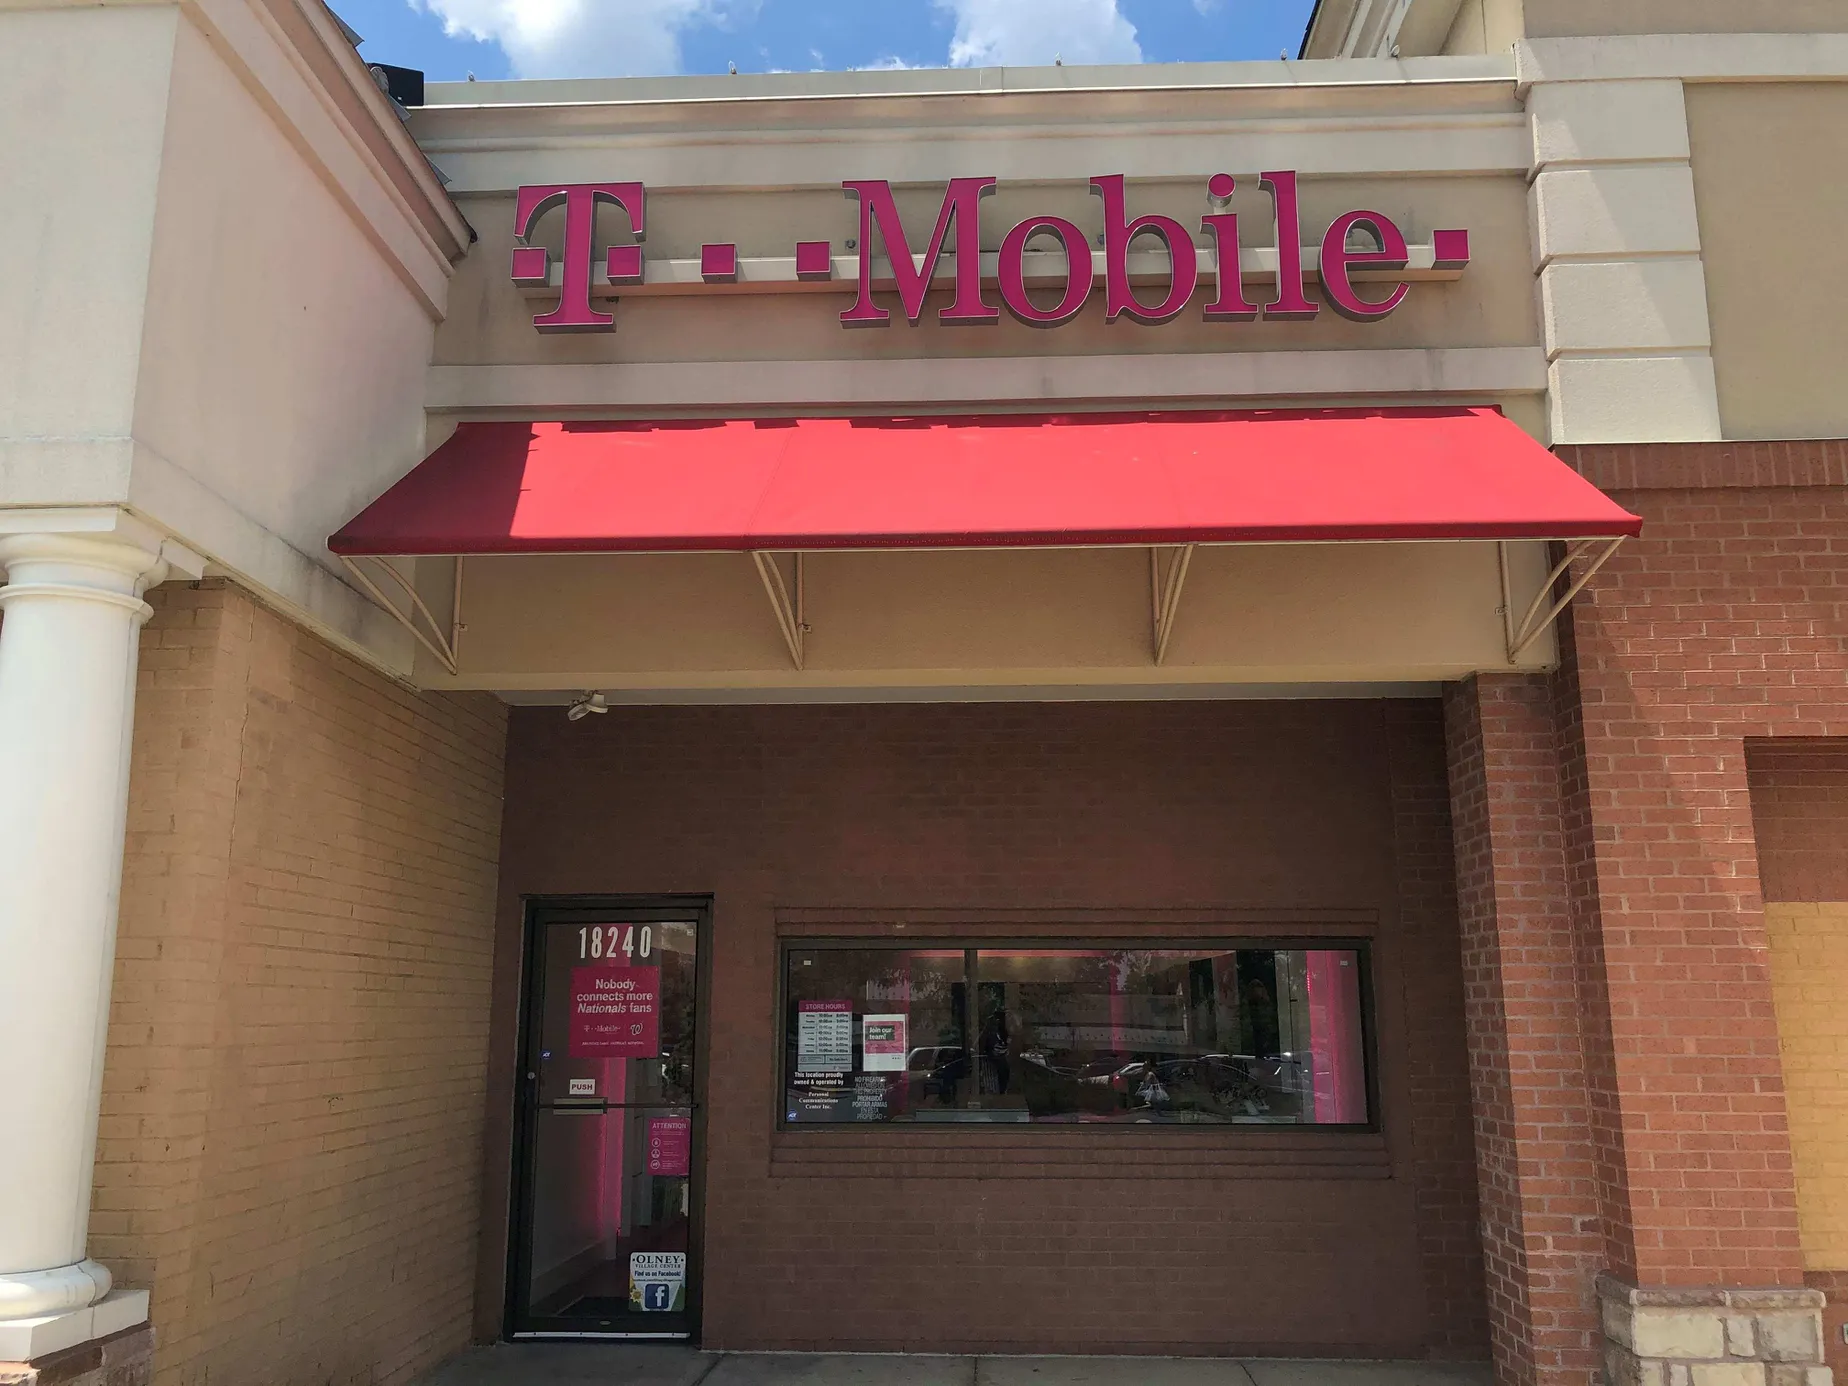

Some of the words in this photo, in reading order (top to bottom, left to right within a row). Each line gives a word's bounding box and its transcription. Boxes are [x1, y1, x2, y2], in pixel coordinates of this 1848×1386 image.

[579, 926, 652, 958] 18240
[595, 978, 636, 991] Nobody
[576, 992, 624, 1001] connects
[626, 992, 653, 1001] more
[577, 1002, 626, 1013] Nationals
[629, 1002, 652, 1013] fans
[571, 1083, 593, 1091] PUSH
[636, 1254, 680, 1264] OLNEY
